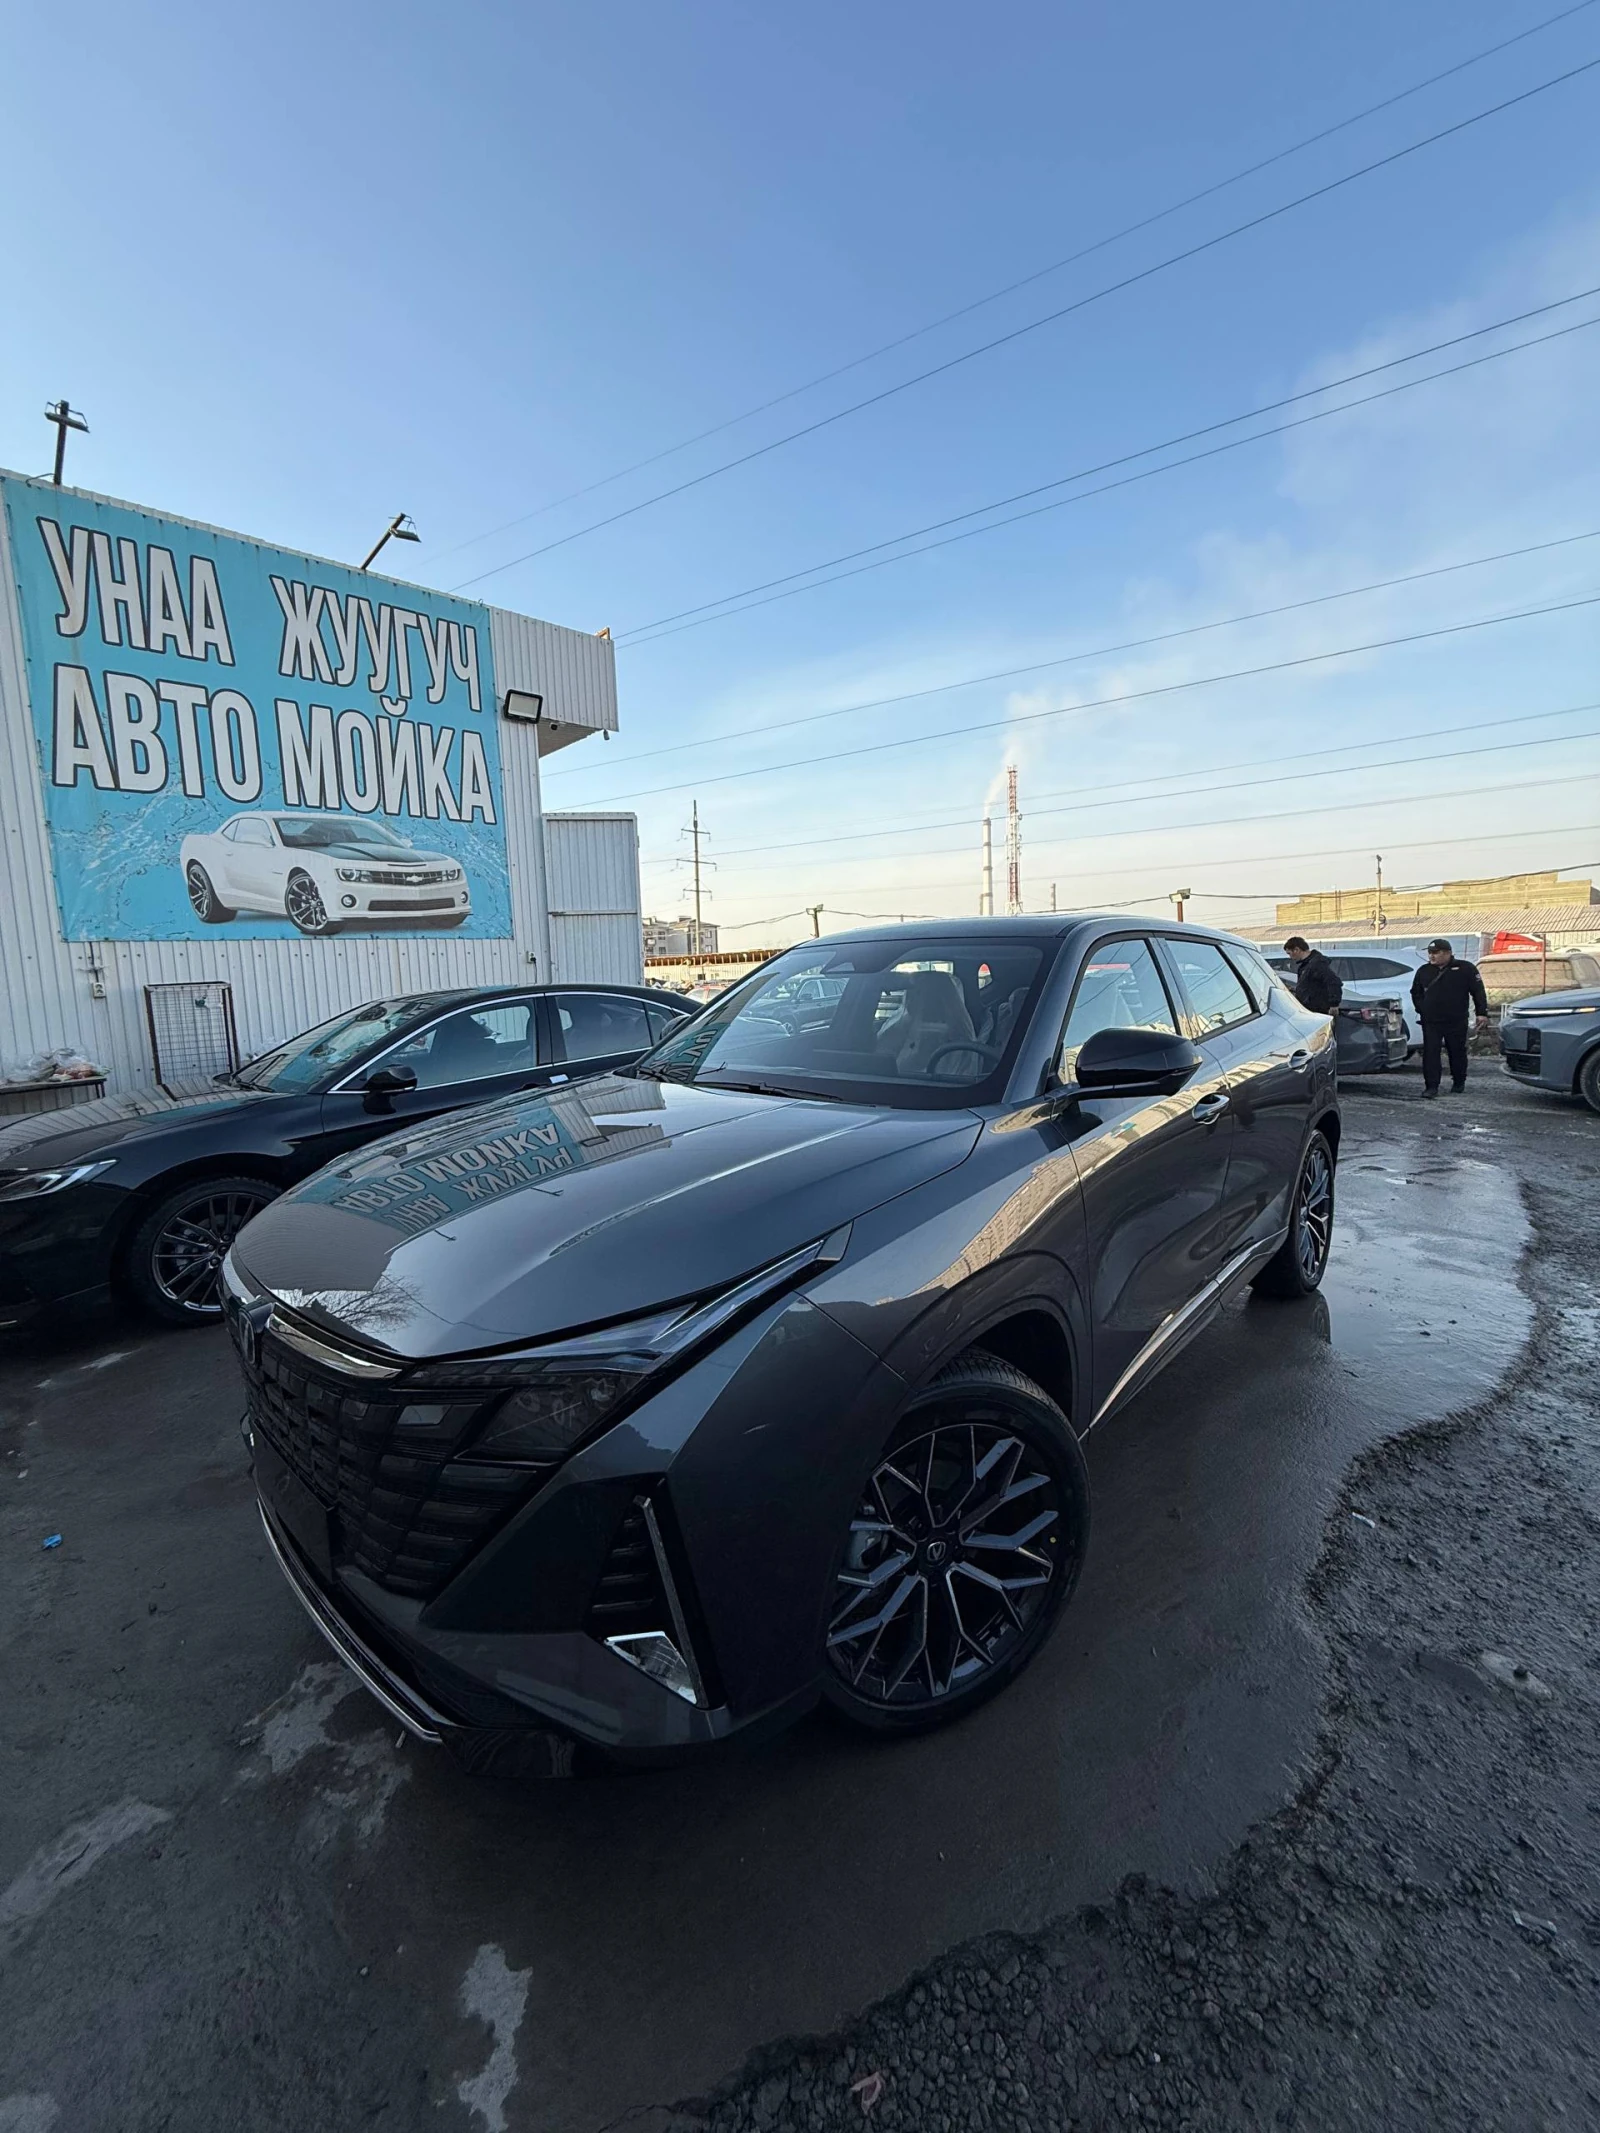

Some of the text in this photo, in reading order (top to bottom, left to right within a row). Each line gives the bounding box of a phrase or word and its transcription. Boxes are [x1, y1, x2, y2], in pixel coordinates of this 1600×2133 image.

[36, 516, 482, 712] УНАА ЖУУГУЧ
[52, 663, 497, 825] АВТО МОЙКА
